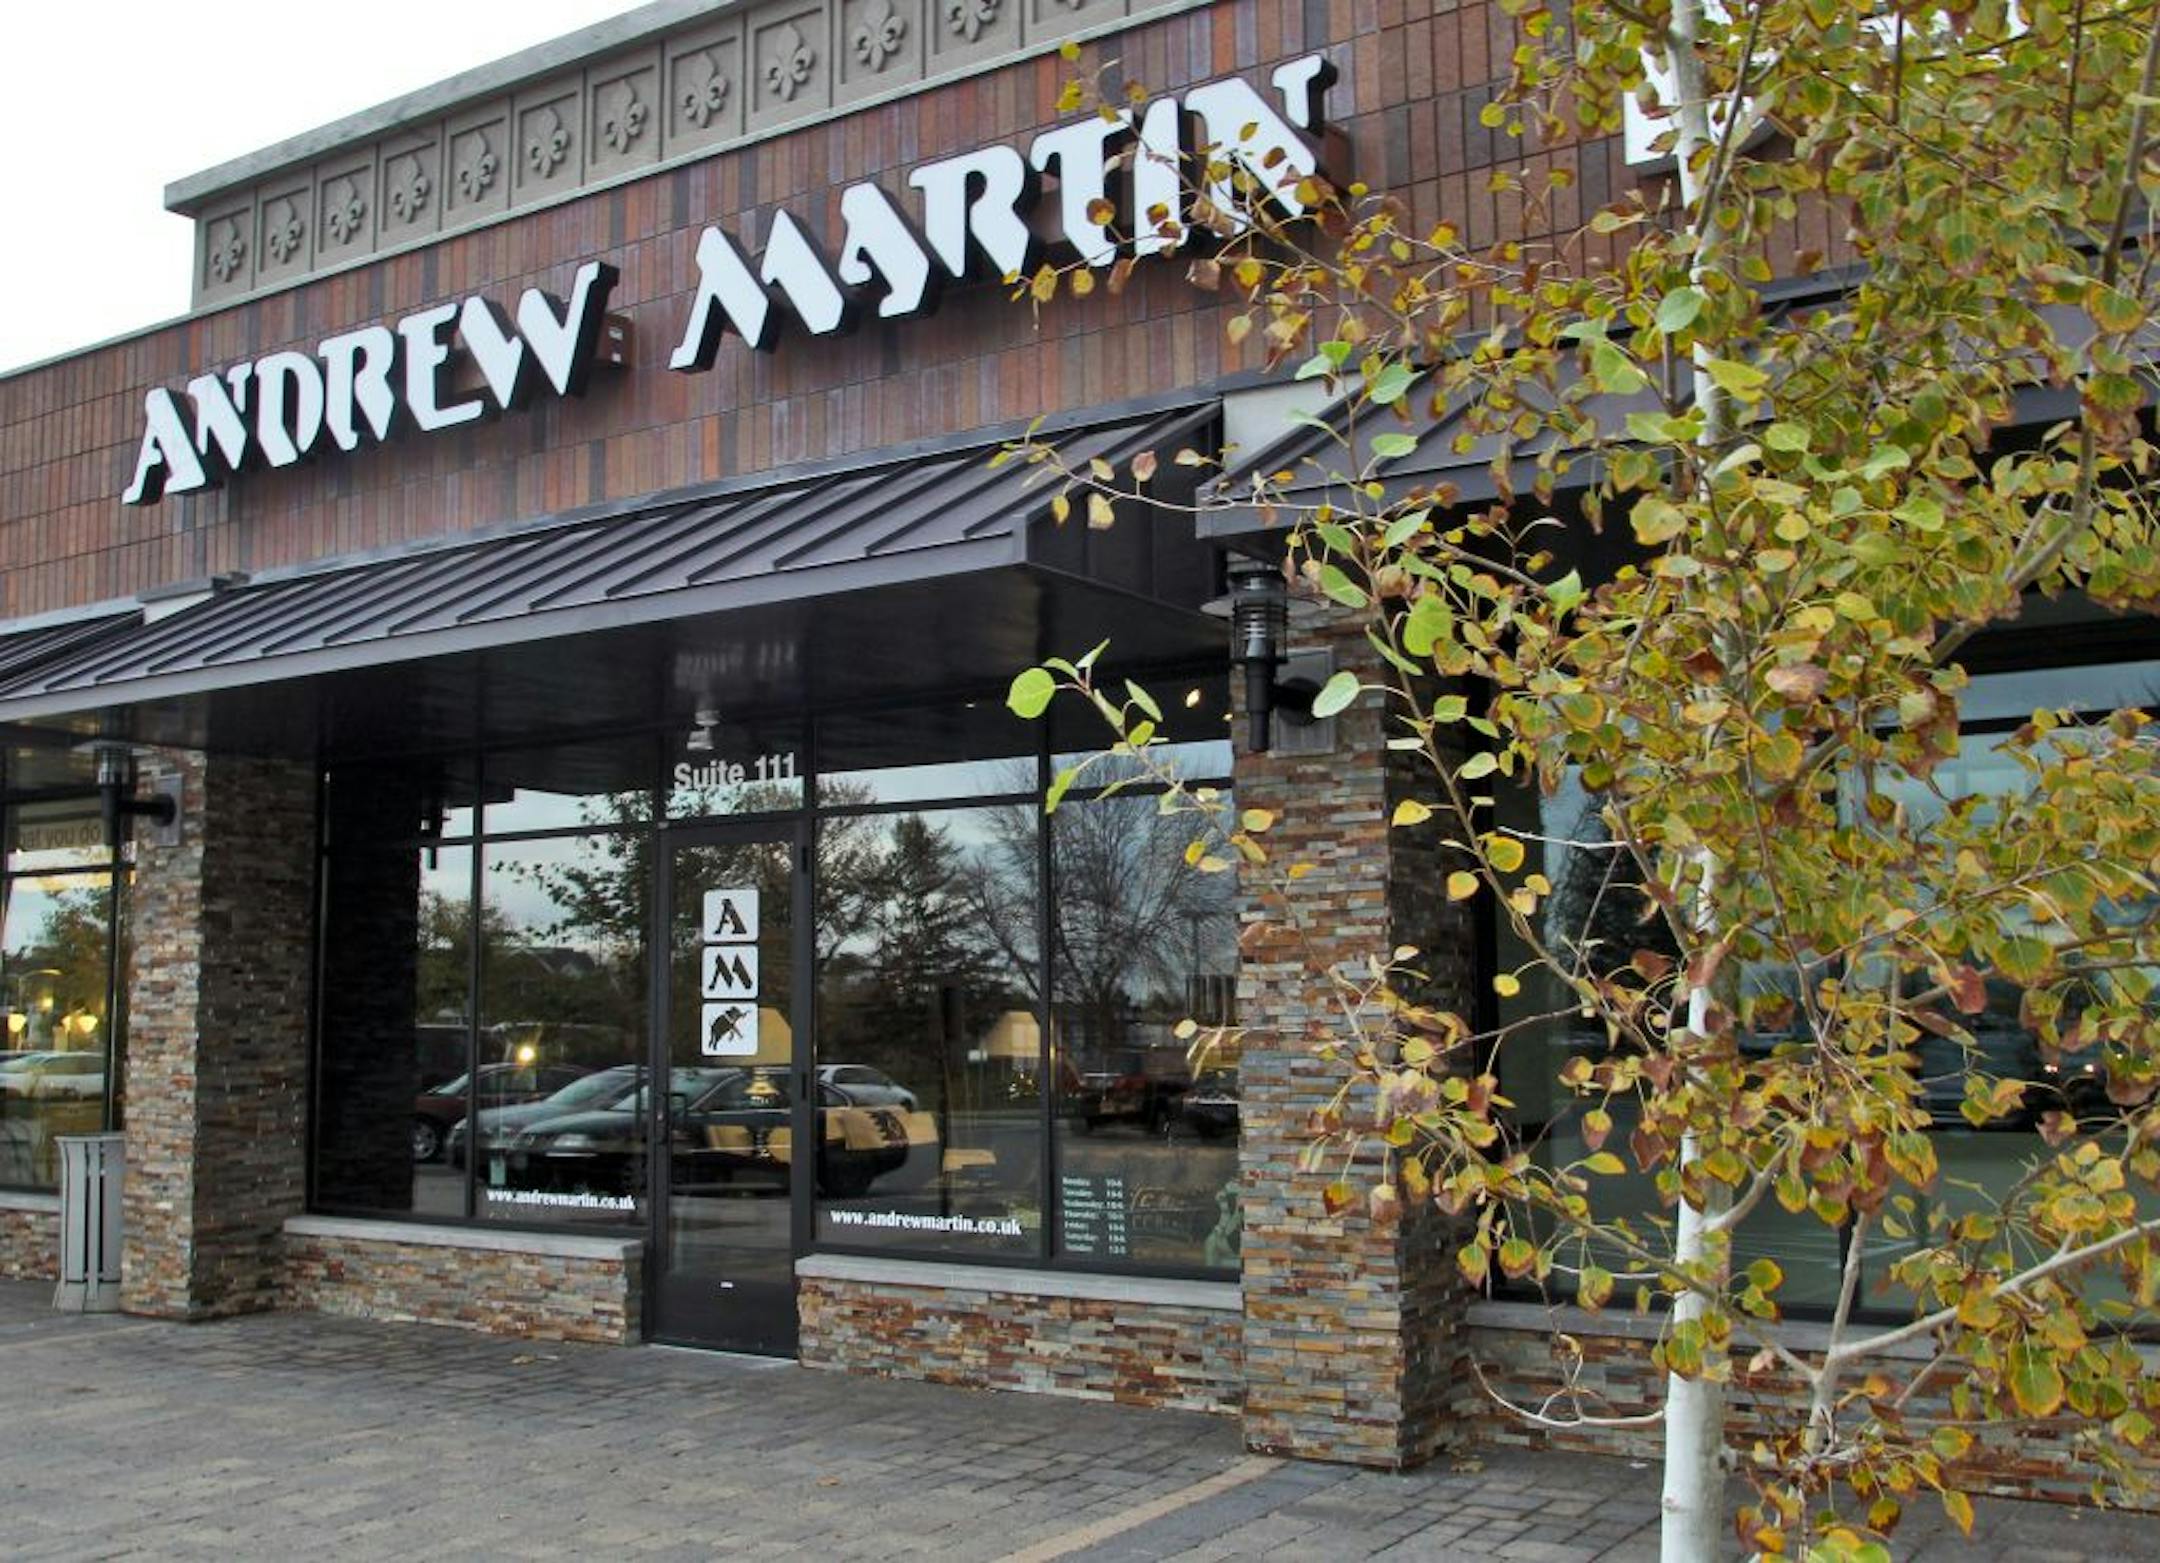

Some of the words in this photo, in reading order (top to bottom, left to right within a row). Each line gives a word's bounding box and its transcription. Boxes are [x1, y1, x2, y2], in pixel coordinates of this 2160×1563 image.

[122, 260, 600, 504] ANDREW
[669, 54, 1323, 371] MARTIN
[674, 759, 746, 790] Suite
[754, 751, 795, 782] 111
[713, 898, 748, 935] A
[708, 952, 753, 990] M
[486, 1188, 636, 1211] www.andrewmartin.co.uk
[830, 1209, 1022, 1236] www.andrewmartin.co.uk
